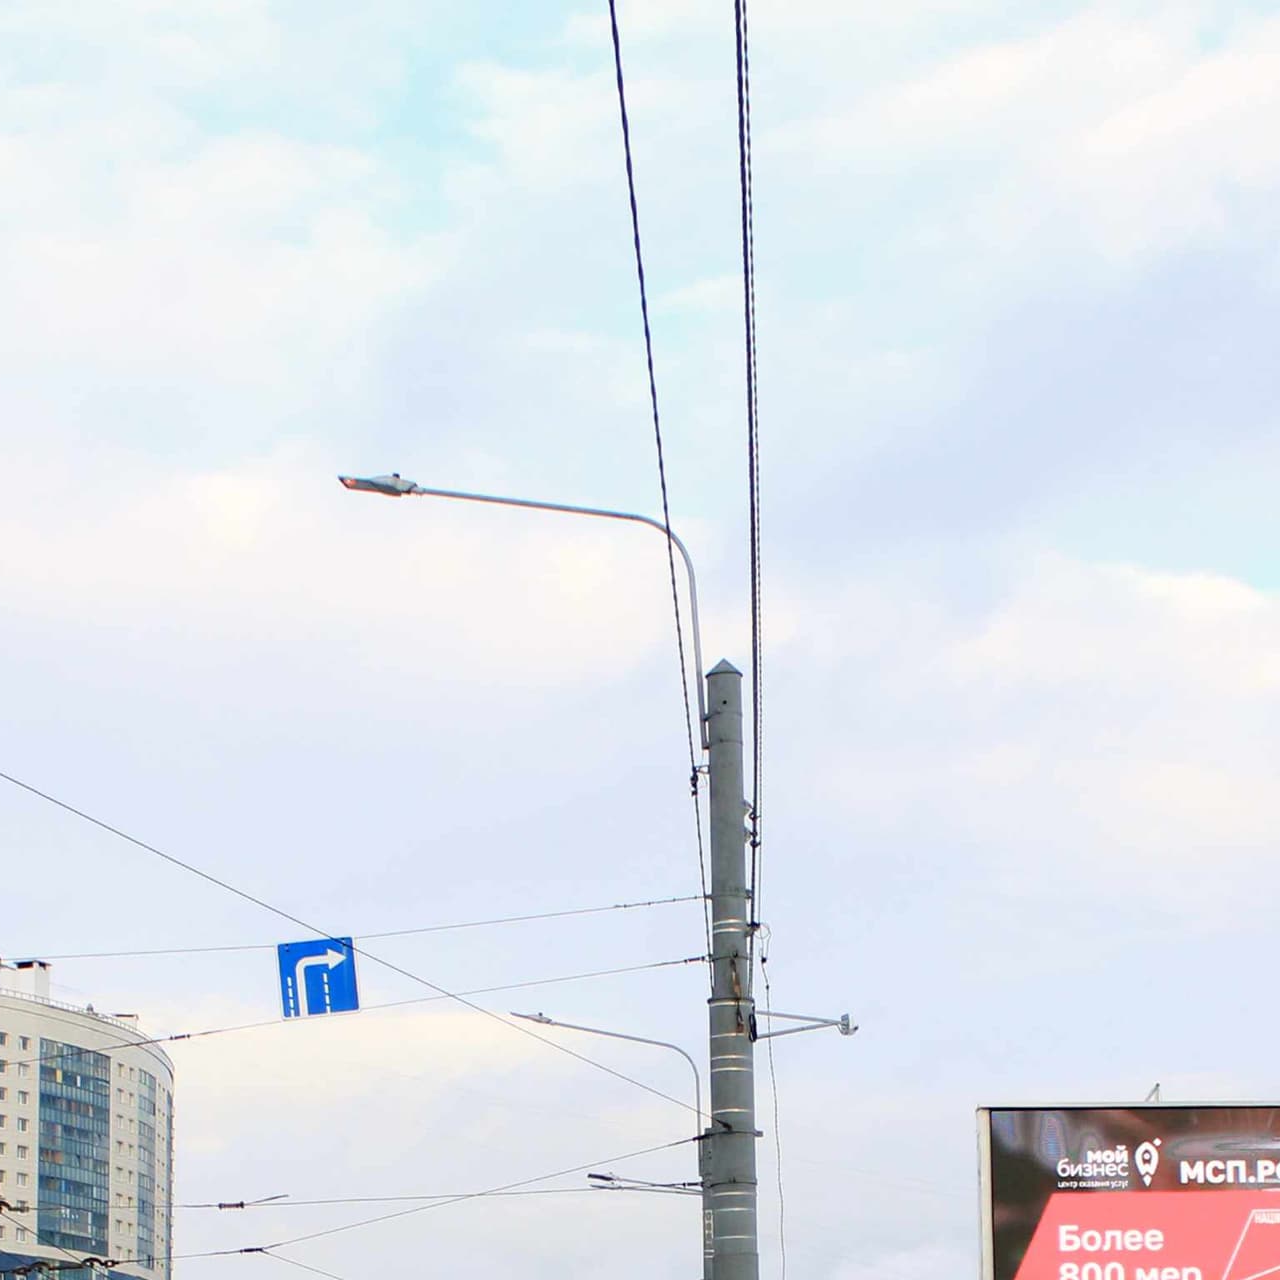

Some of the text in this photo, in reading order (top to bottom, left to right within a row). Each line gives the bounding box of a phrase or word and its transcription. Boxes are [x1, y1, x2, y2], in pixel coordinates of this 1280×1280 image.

[1087, 1145, 1128, 1163] мой
[1057, 1158, 1128, 1177] бизнес
[1058, 1225, 1164, 1251] Более
